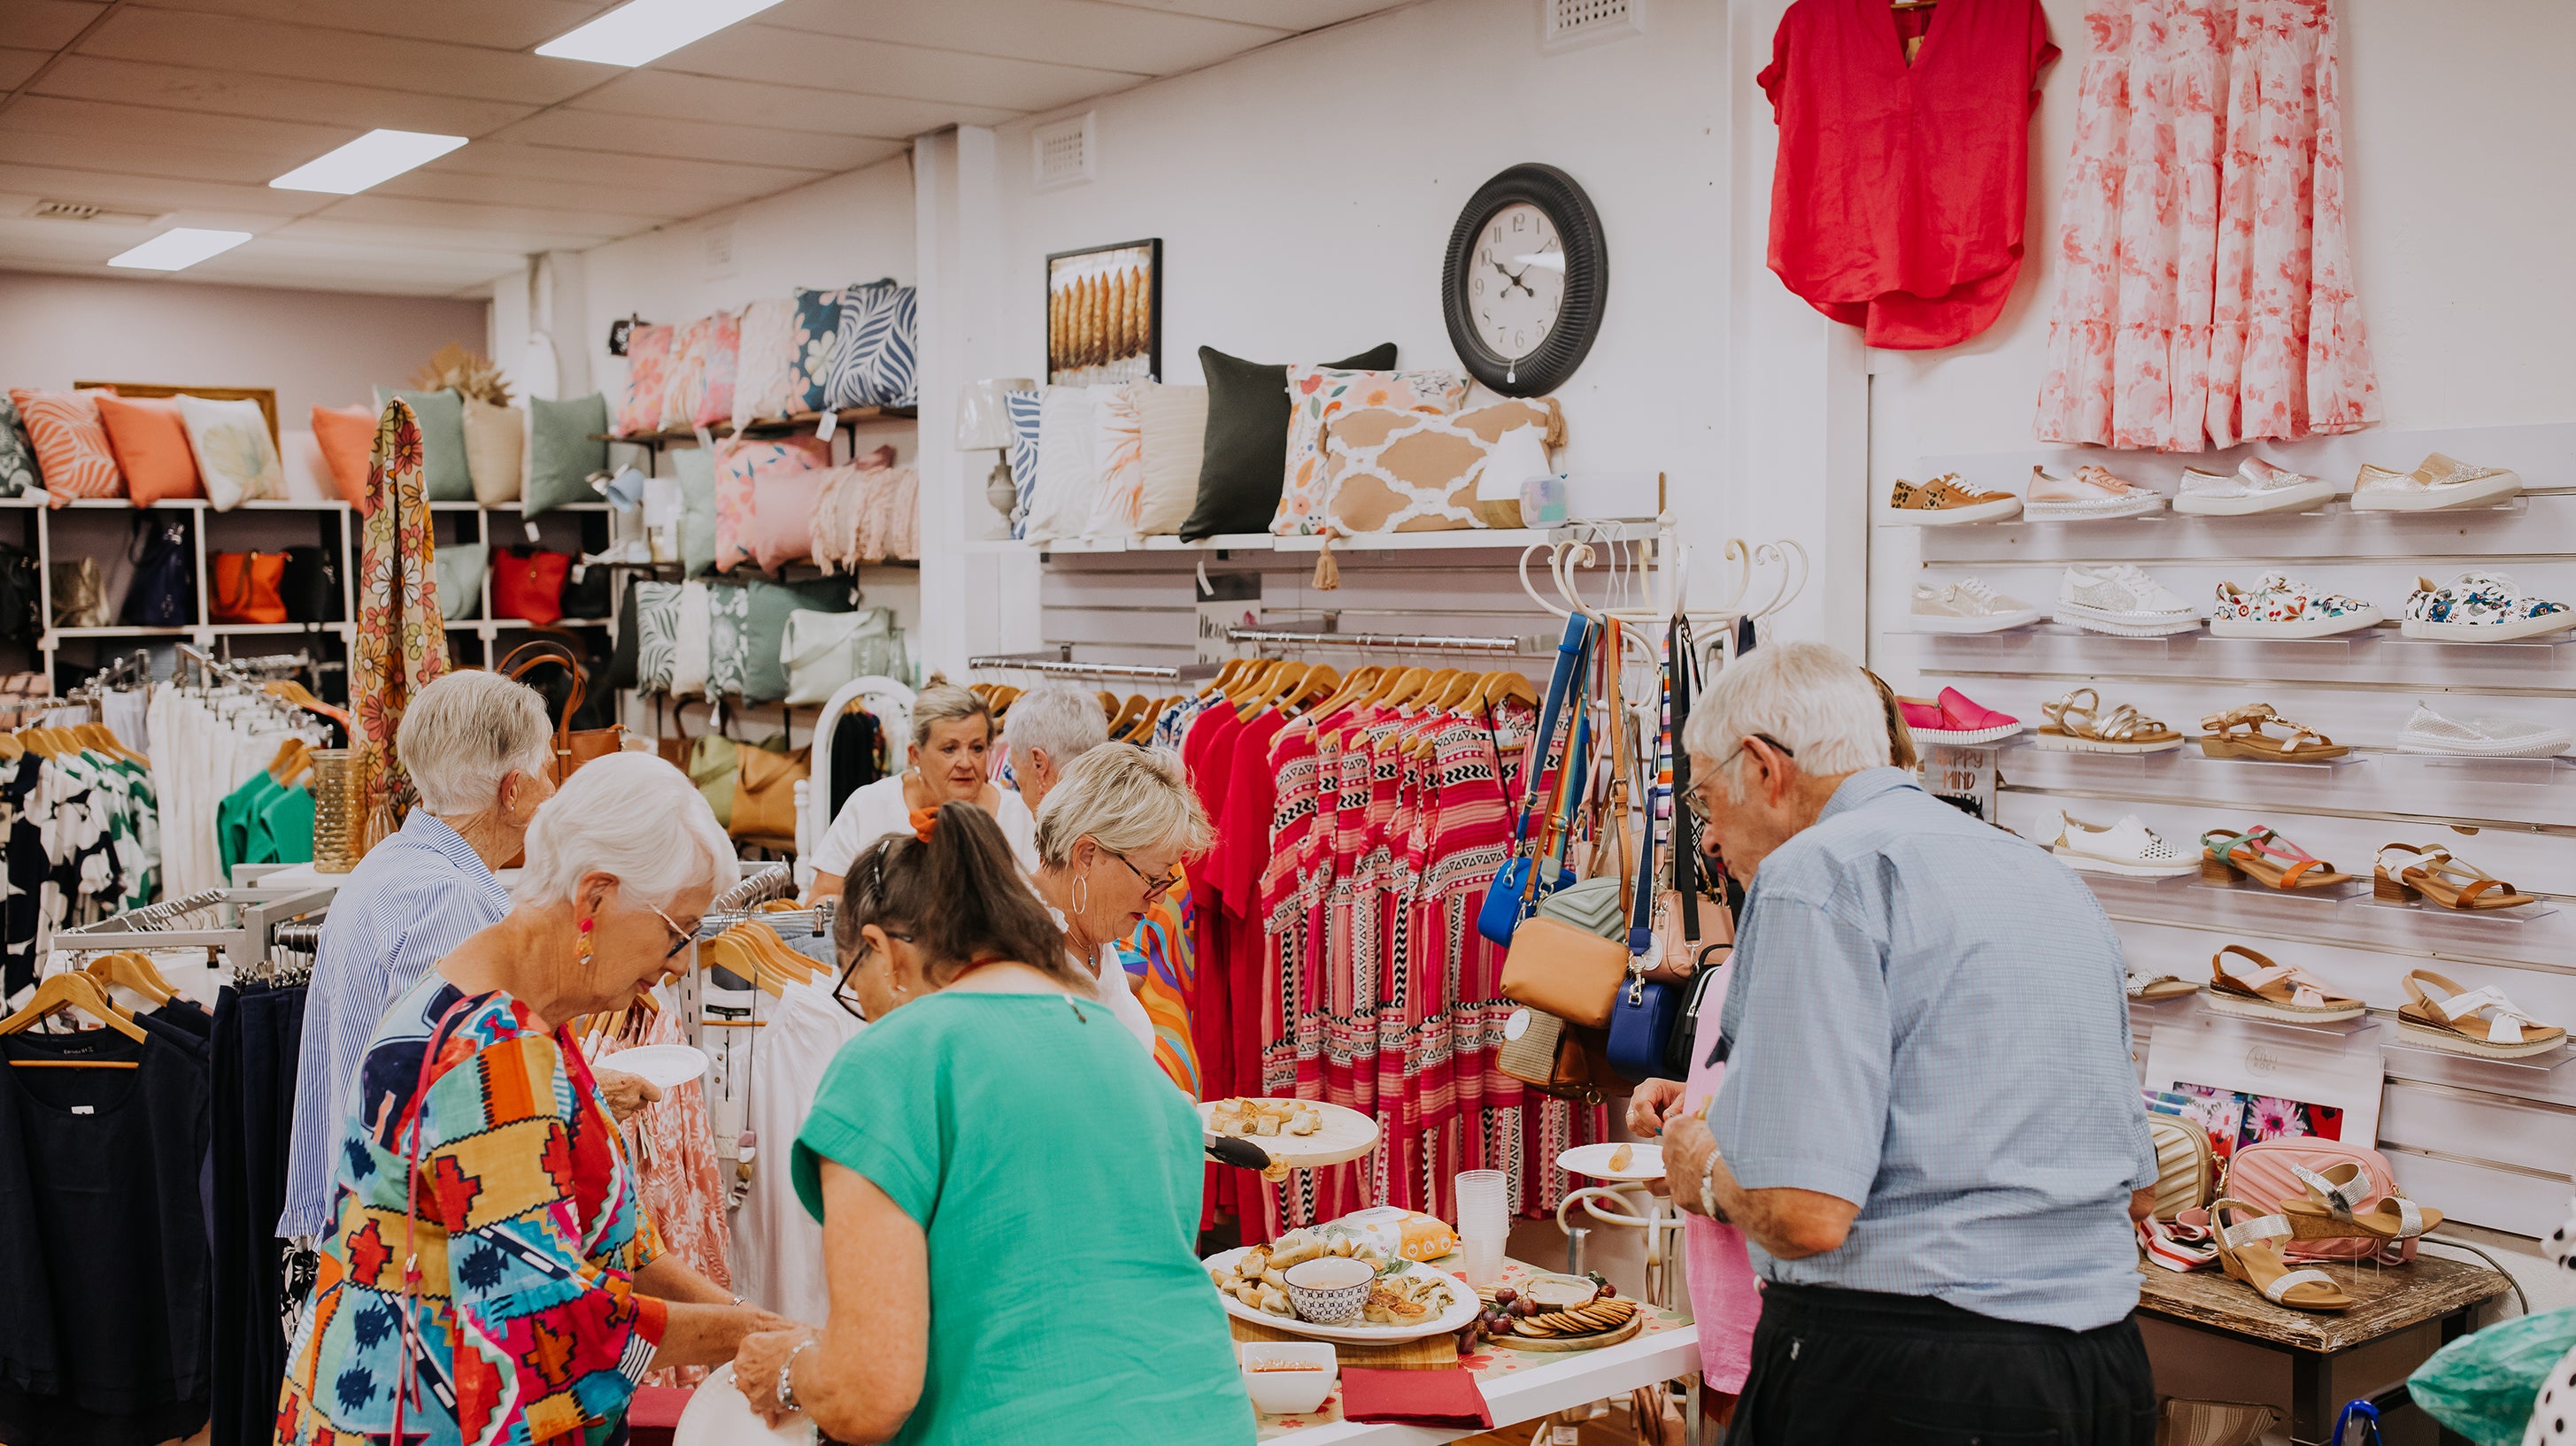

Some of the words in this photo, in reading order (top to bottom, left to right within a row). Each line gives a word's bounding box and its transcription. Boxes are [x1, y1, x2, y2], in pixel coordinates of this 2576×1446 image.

[1512, 212, 1525, 233] 12
[1493, 226, 1502, 243] 11
[1481, 248, 1493, 267] 10
[1475, 278, 1485, 296] 9
[1483, 307, 1492, 327] 8
[1498, 326, 1507, 343] 7
[1536, 319, 1546, 338] 5
[1515, 329, 1524, 349] 6
[1934, 749, 1984, 769] HAPPY
[1942, 769, 1976, 790] MIND
[2254, 1053, 2278, 1063] LILLI
